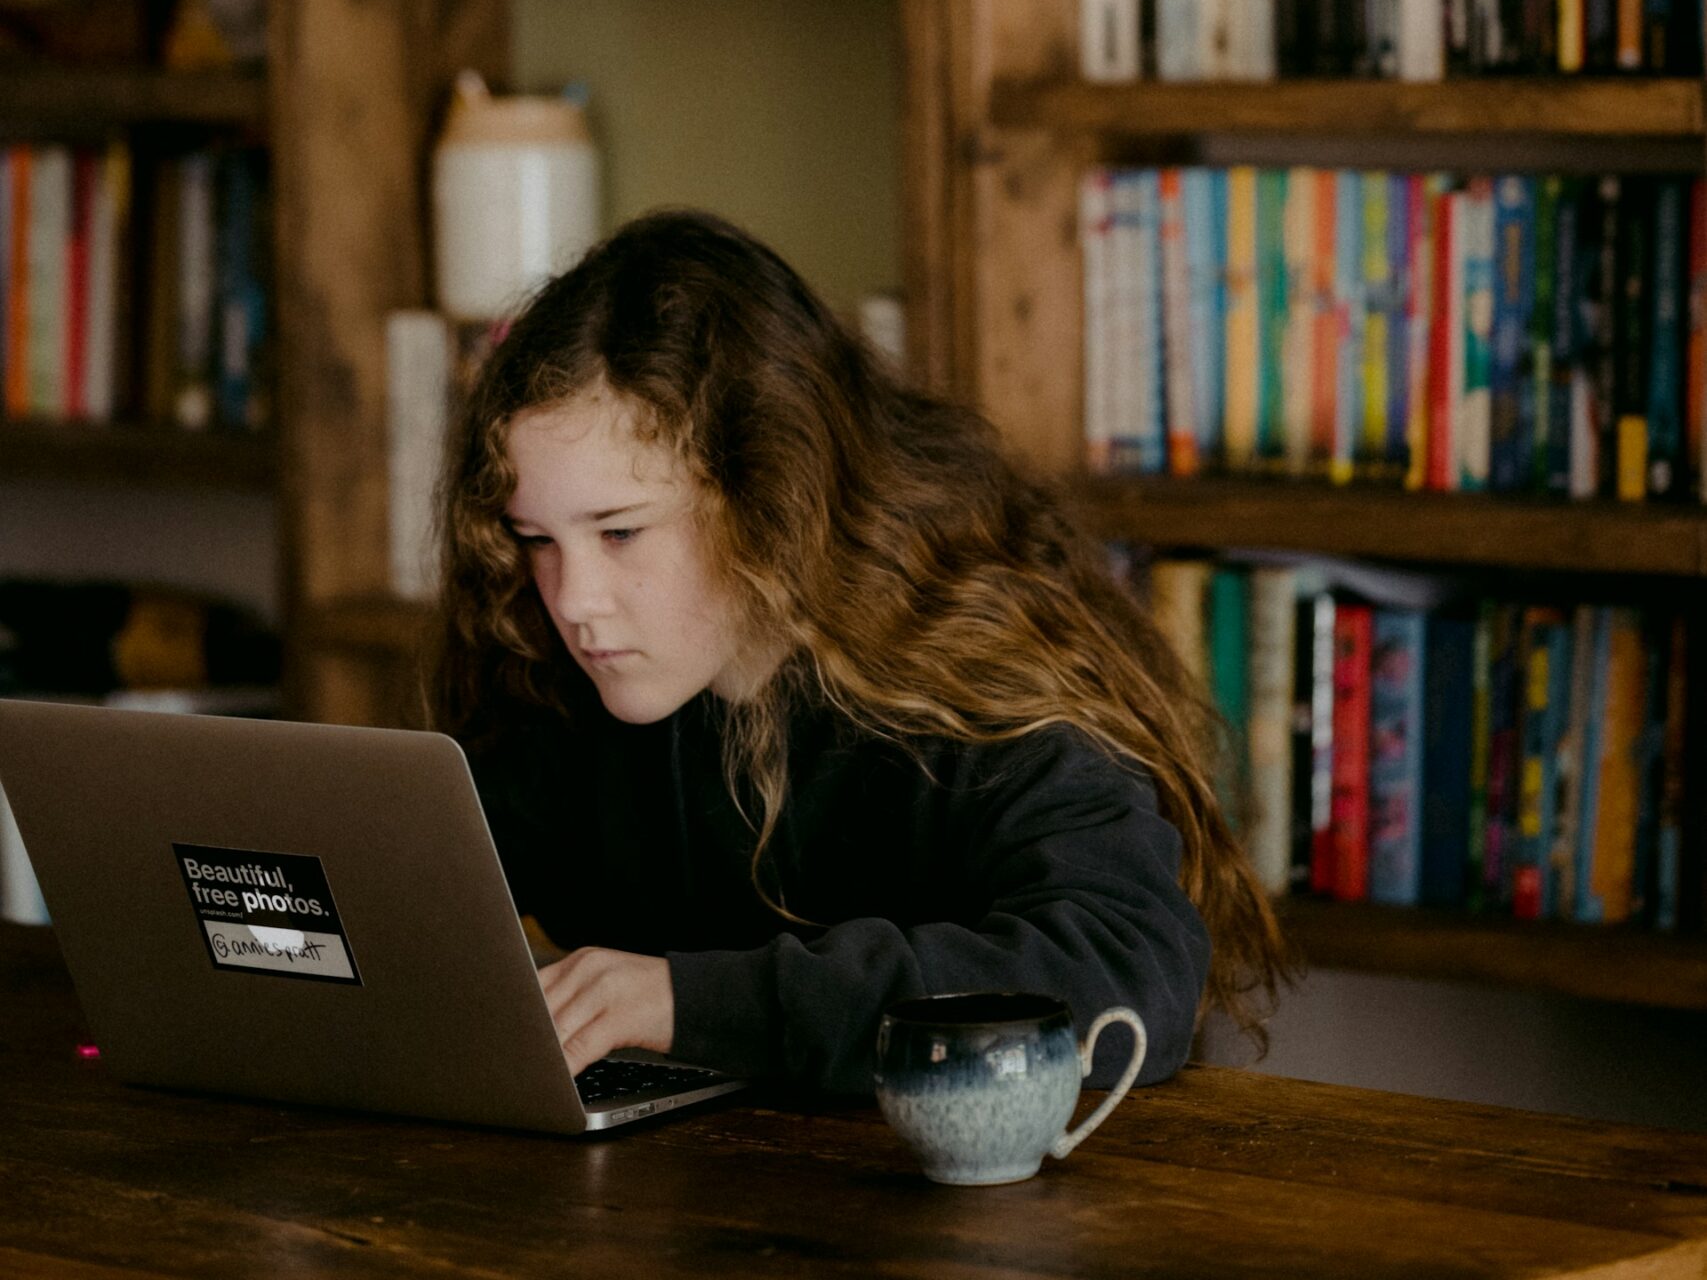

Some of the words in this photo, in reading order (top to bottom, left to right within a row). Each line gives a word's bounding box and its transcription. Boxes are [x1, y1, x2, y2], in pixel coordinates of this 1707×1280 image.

[183, 857, 294, 893] Beautiful,
[191, 882, 239, 906] free
[241, 888, 330, 917] photos.
